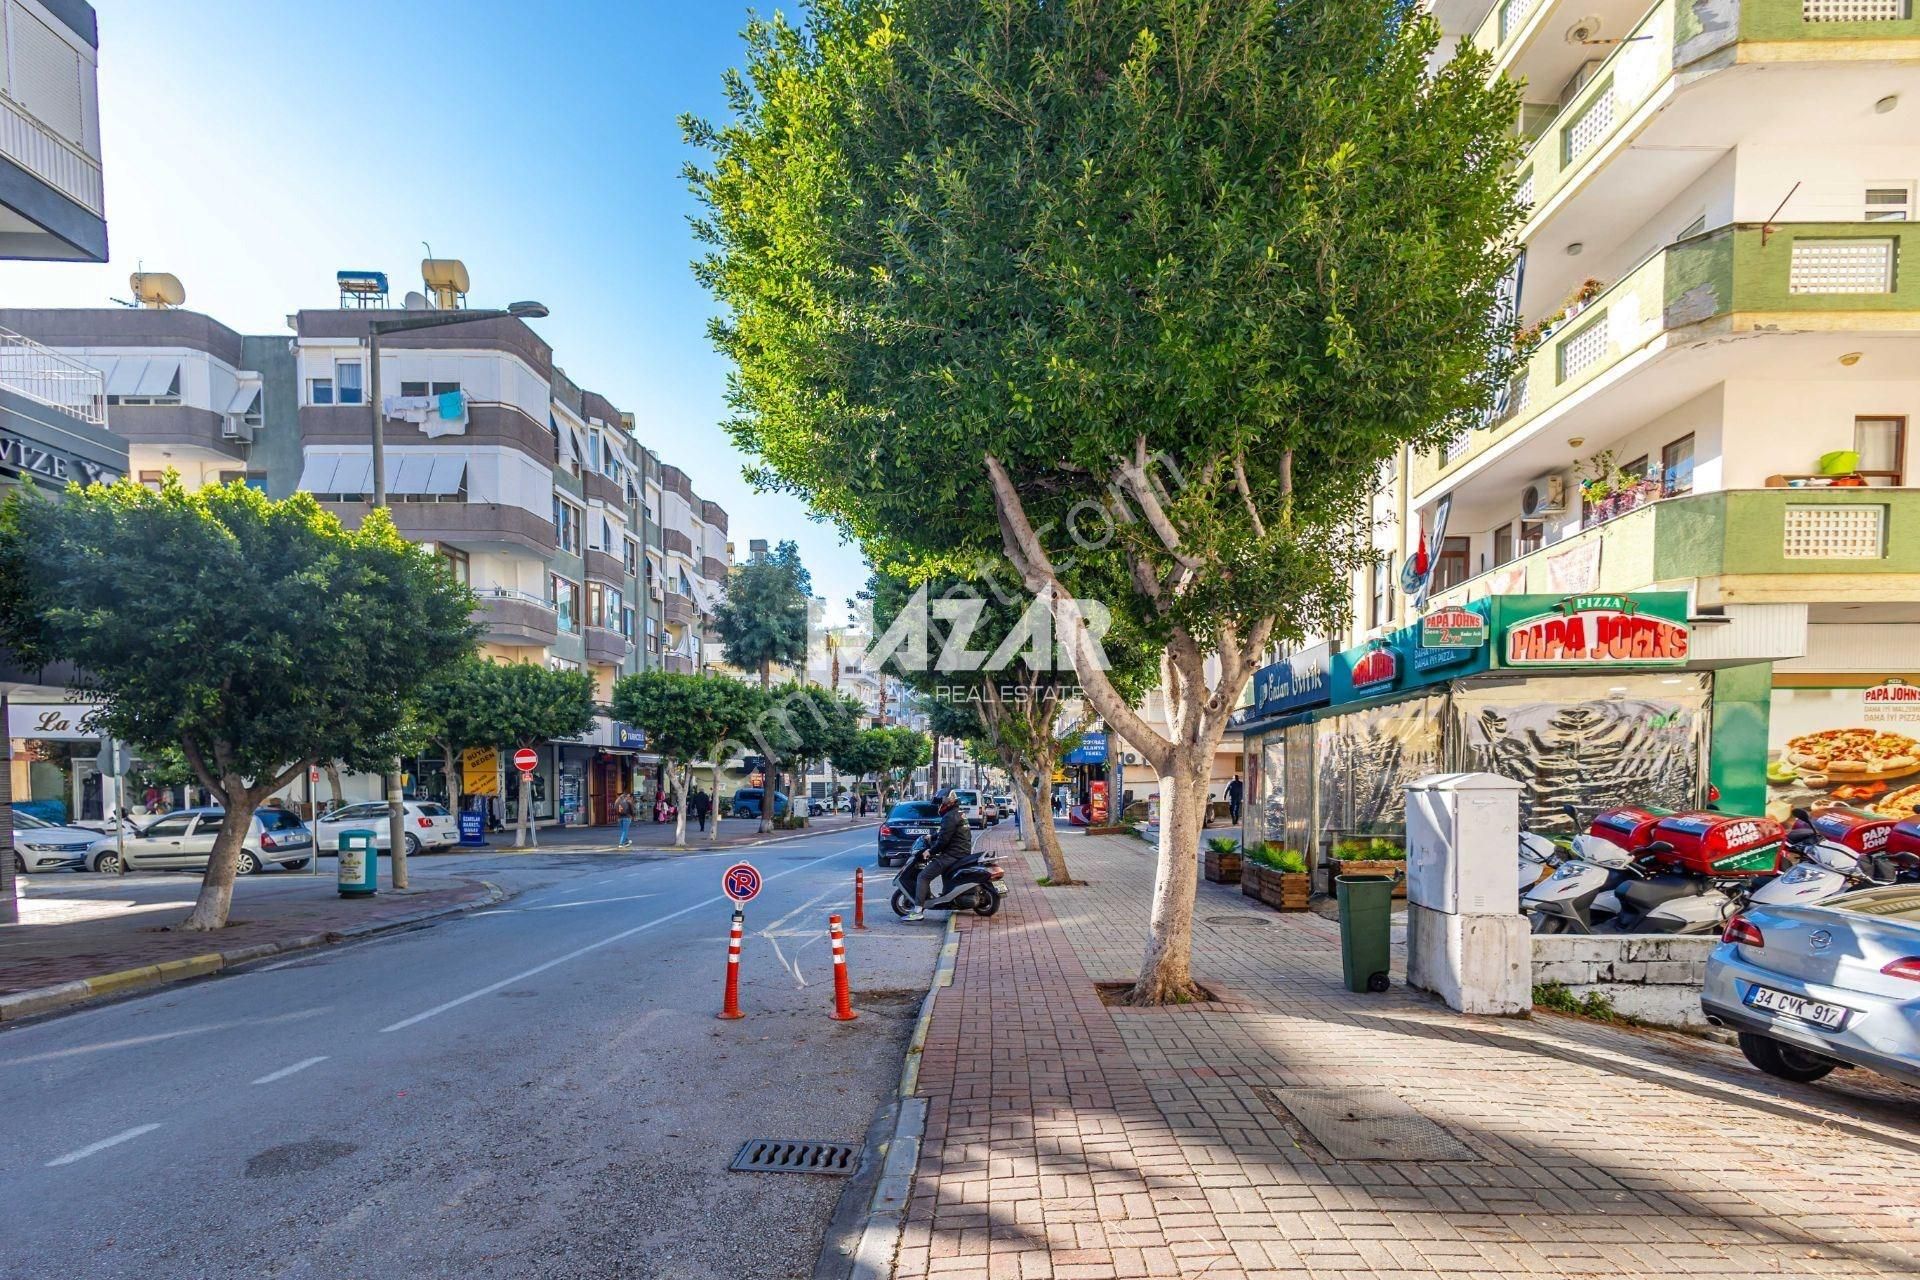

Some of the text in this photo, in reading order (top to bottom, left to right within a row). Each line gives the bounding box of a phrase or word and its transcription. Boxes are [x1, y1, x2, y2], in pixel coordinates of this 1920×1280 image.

[1577, 597, 1621, 609] PIZZA
[1426, 613, 1480, 628] PAPA JOHNS
[1512, 615, 1687, 659] PAPA JOHNS
[1865, 688, 1889, 700] PAPA
[33, 711, 70, 732] La
[1725, 822, 1757, 840] PAPA
[1727, 831, 1760, 849] JOHNS
[1862, 836, 1888, 850] JOHN
[1755, 989, 1839, 1025] 34 CVK 917
